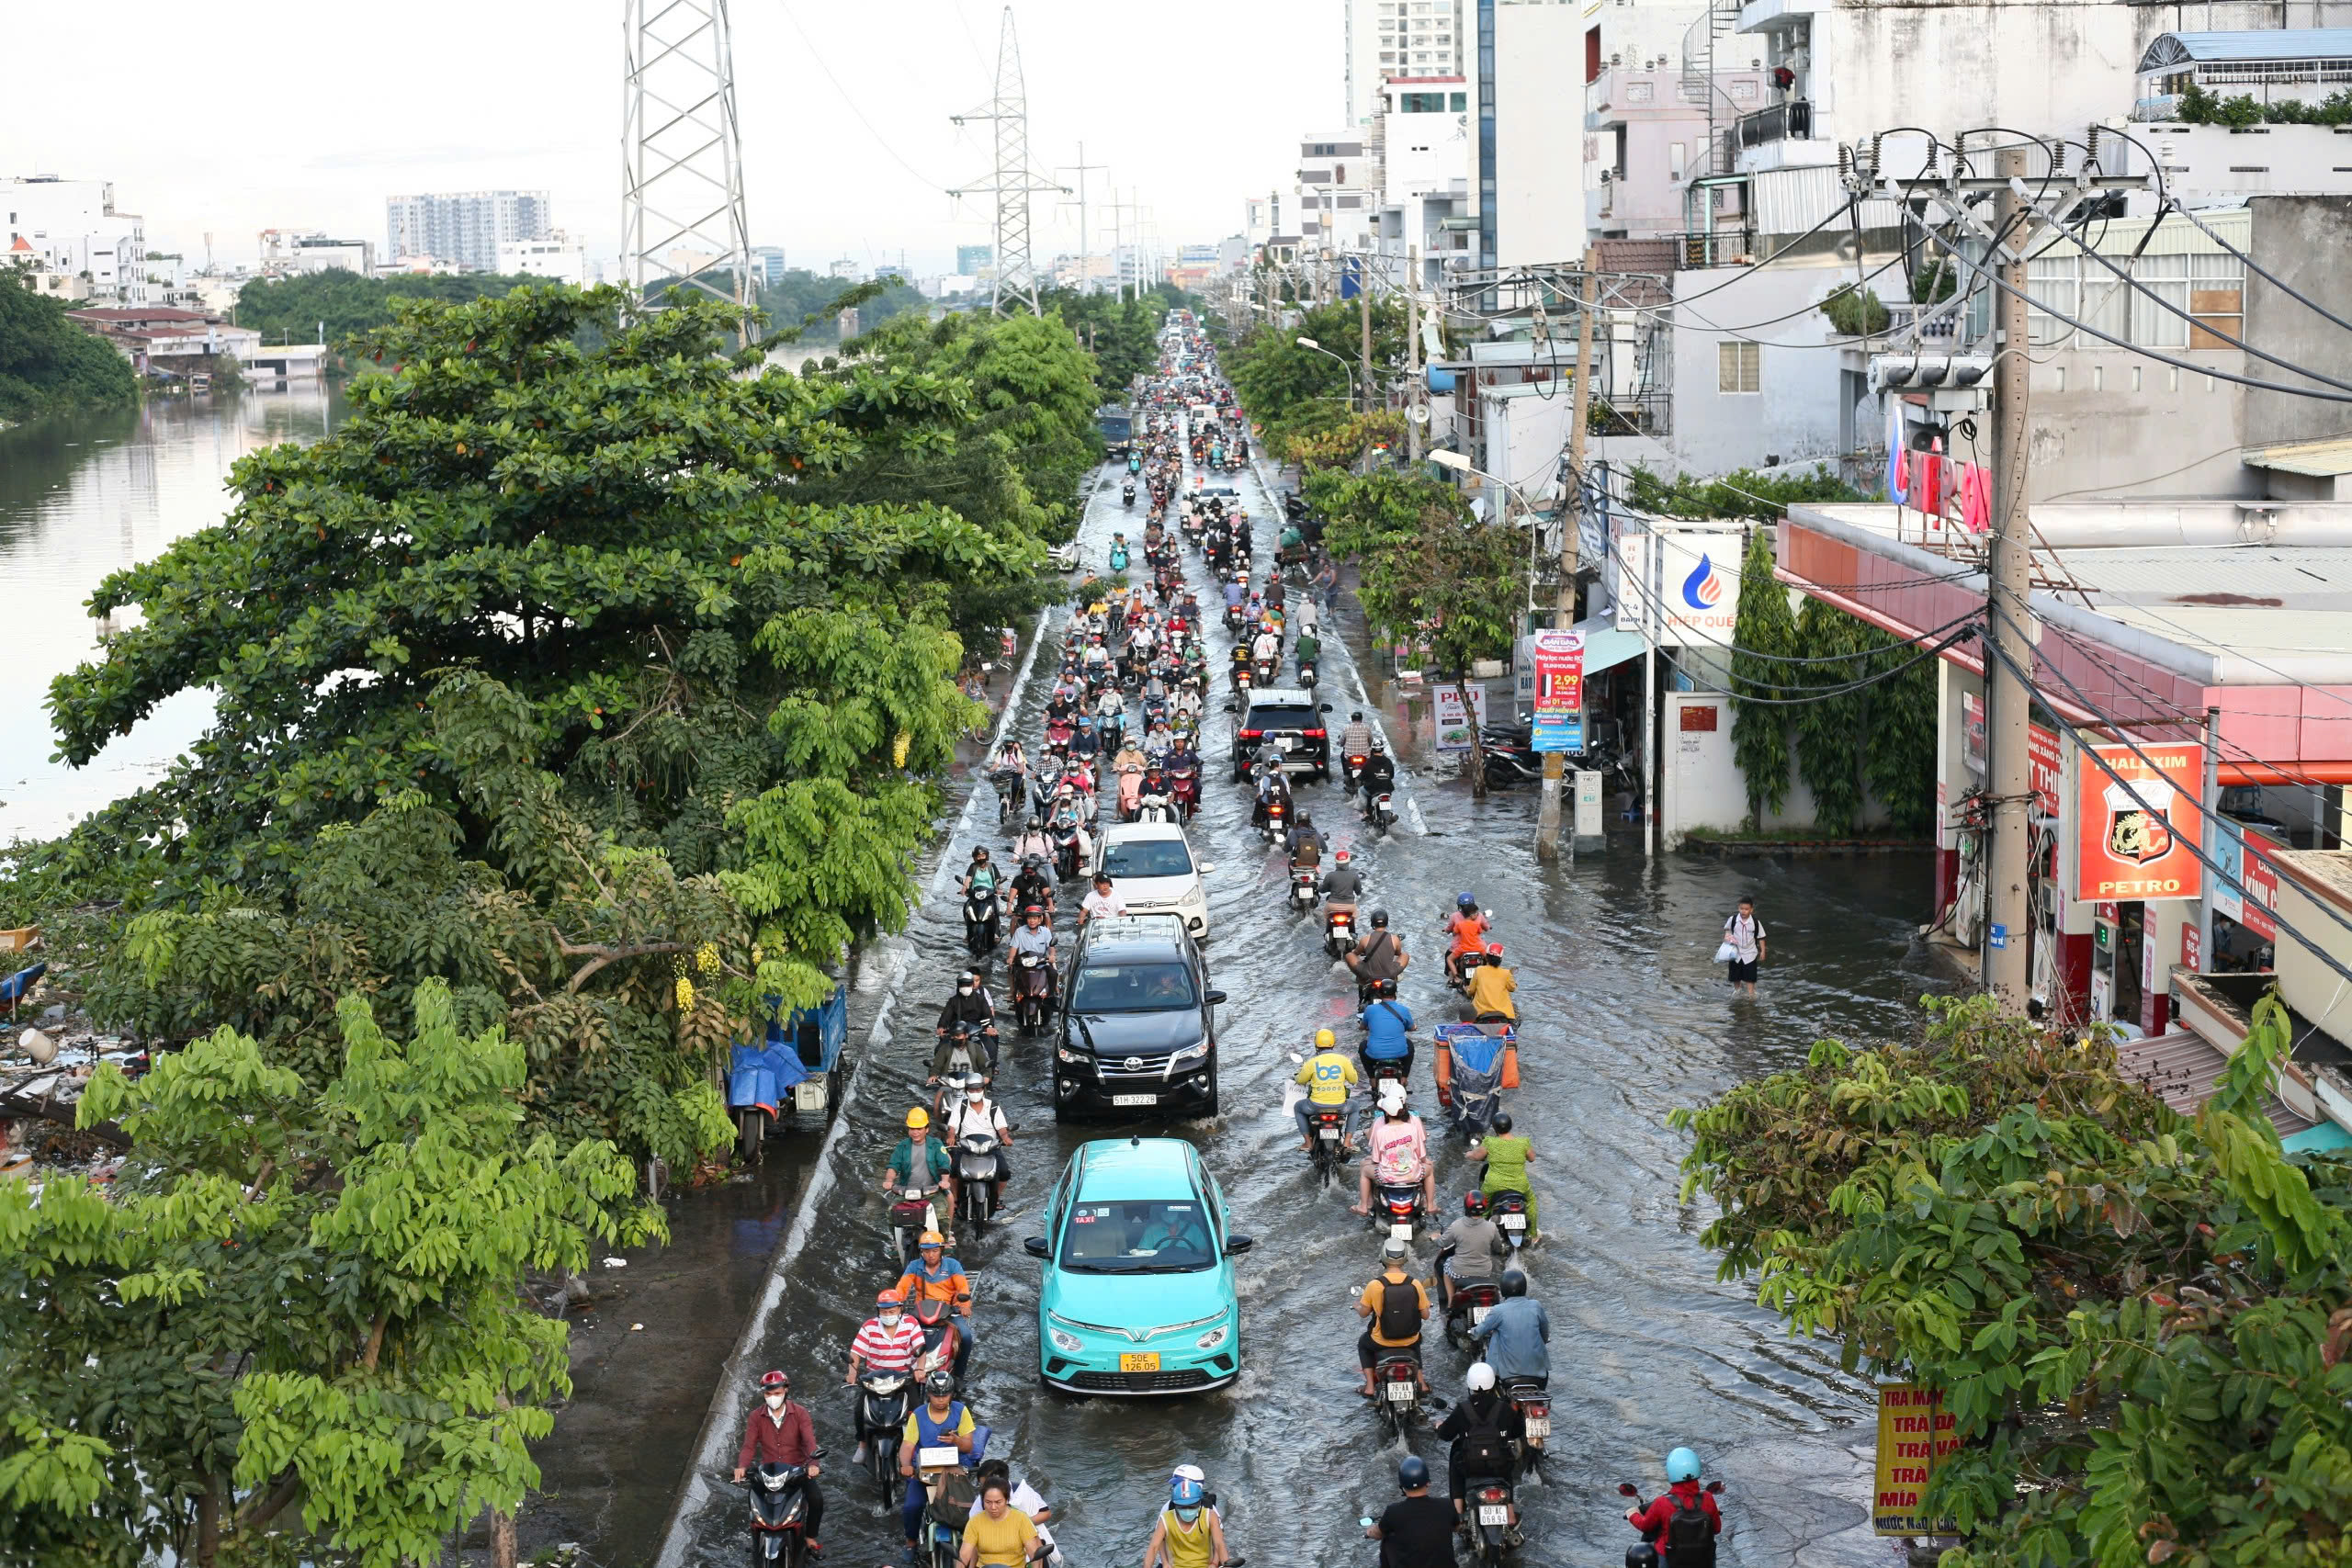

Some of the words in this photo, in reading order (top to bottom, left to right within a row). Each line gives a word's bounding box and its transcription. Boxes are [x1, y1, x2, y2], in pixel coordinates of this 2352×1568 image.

[2099, 879, 2180, 894] PETRO
[1316, 1061, 1341, 1080] be
[1076, 1215, 1096, 1224] TAXI
[1125, 1362, 1156, 1371] 126.05
[1131, 1354, 1148, 1362] 50E
[1884, 1388, 1909, 1407] TRÀ
[1894, 1414, 1929, 1433] TRÀ
[1896, 1439, 1933, 1459] TRÀ
[1892, 1466, 1928, 1483] TRÀ
[1879, 1489, 1917, 1506] MÍA
